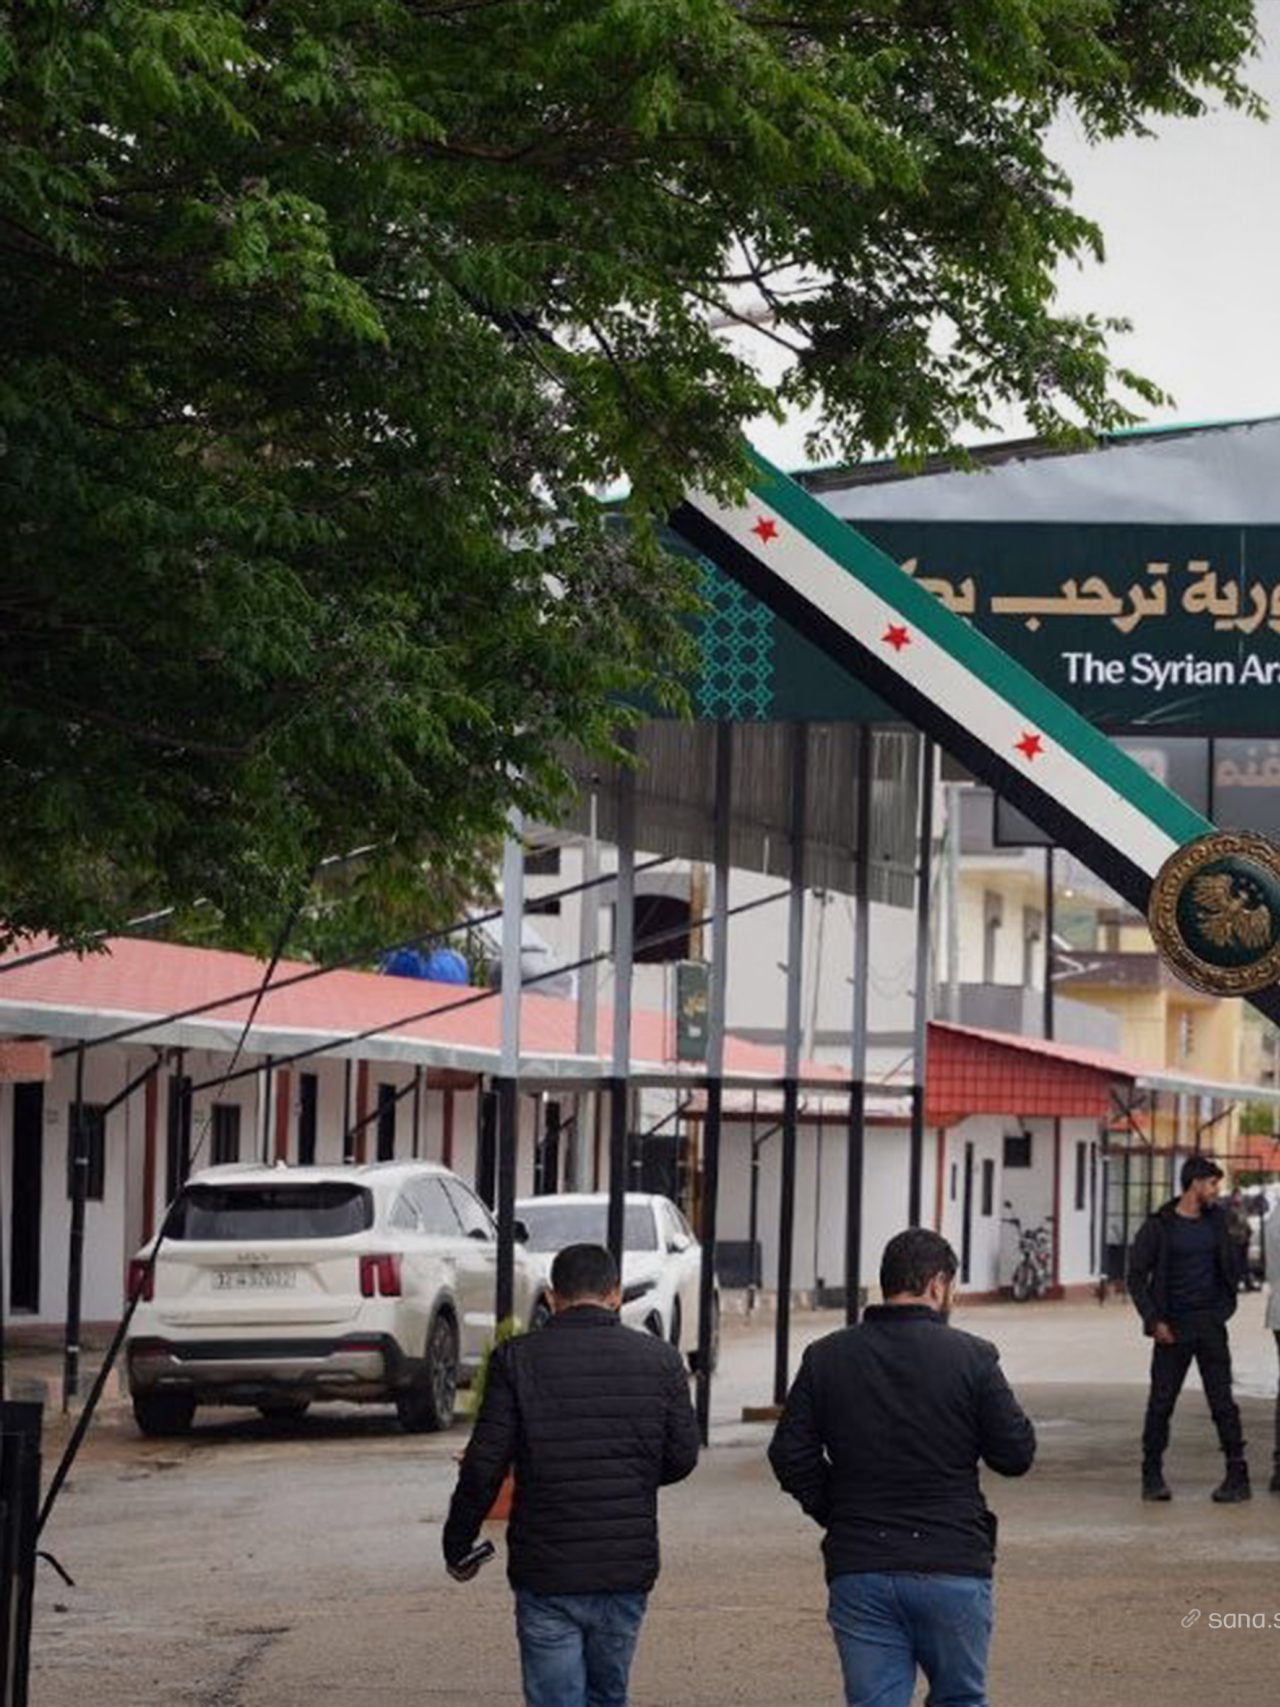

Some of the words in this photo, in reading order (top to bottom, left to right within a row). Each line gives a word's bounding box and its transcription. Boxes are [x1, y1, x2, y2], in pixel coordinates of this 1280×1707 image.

[902, 558, 975, 618] بك
[991, 562, 1166, 632] ترحب
[1061, 652, 1125, 684] The
[1131, 652, 1236, 691] Syrian
